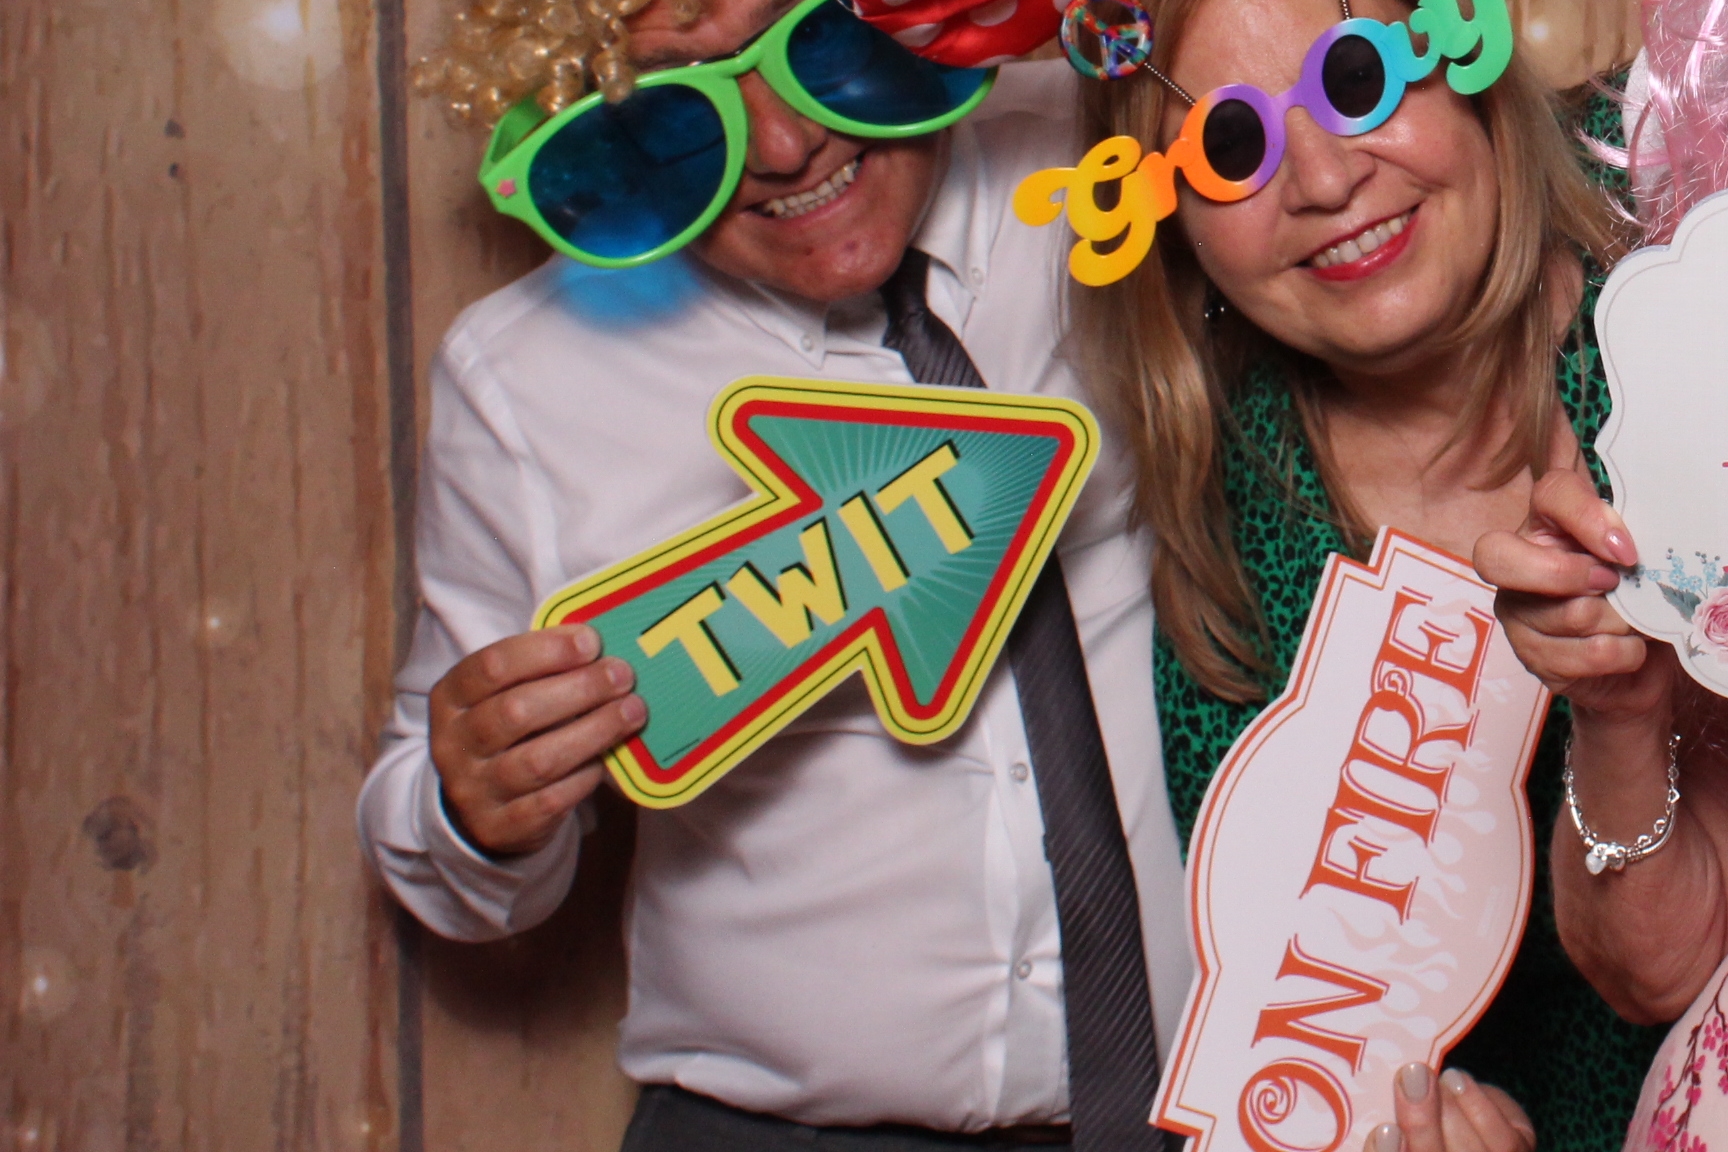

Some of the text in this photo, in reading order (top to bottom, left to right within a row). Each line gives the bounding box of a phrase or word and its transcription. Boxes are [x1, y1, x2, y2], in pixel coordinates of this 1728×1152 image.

[636, 438, 975, 696] TWIT
[1238, 583, 1495, 1152] ON FIRE
